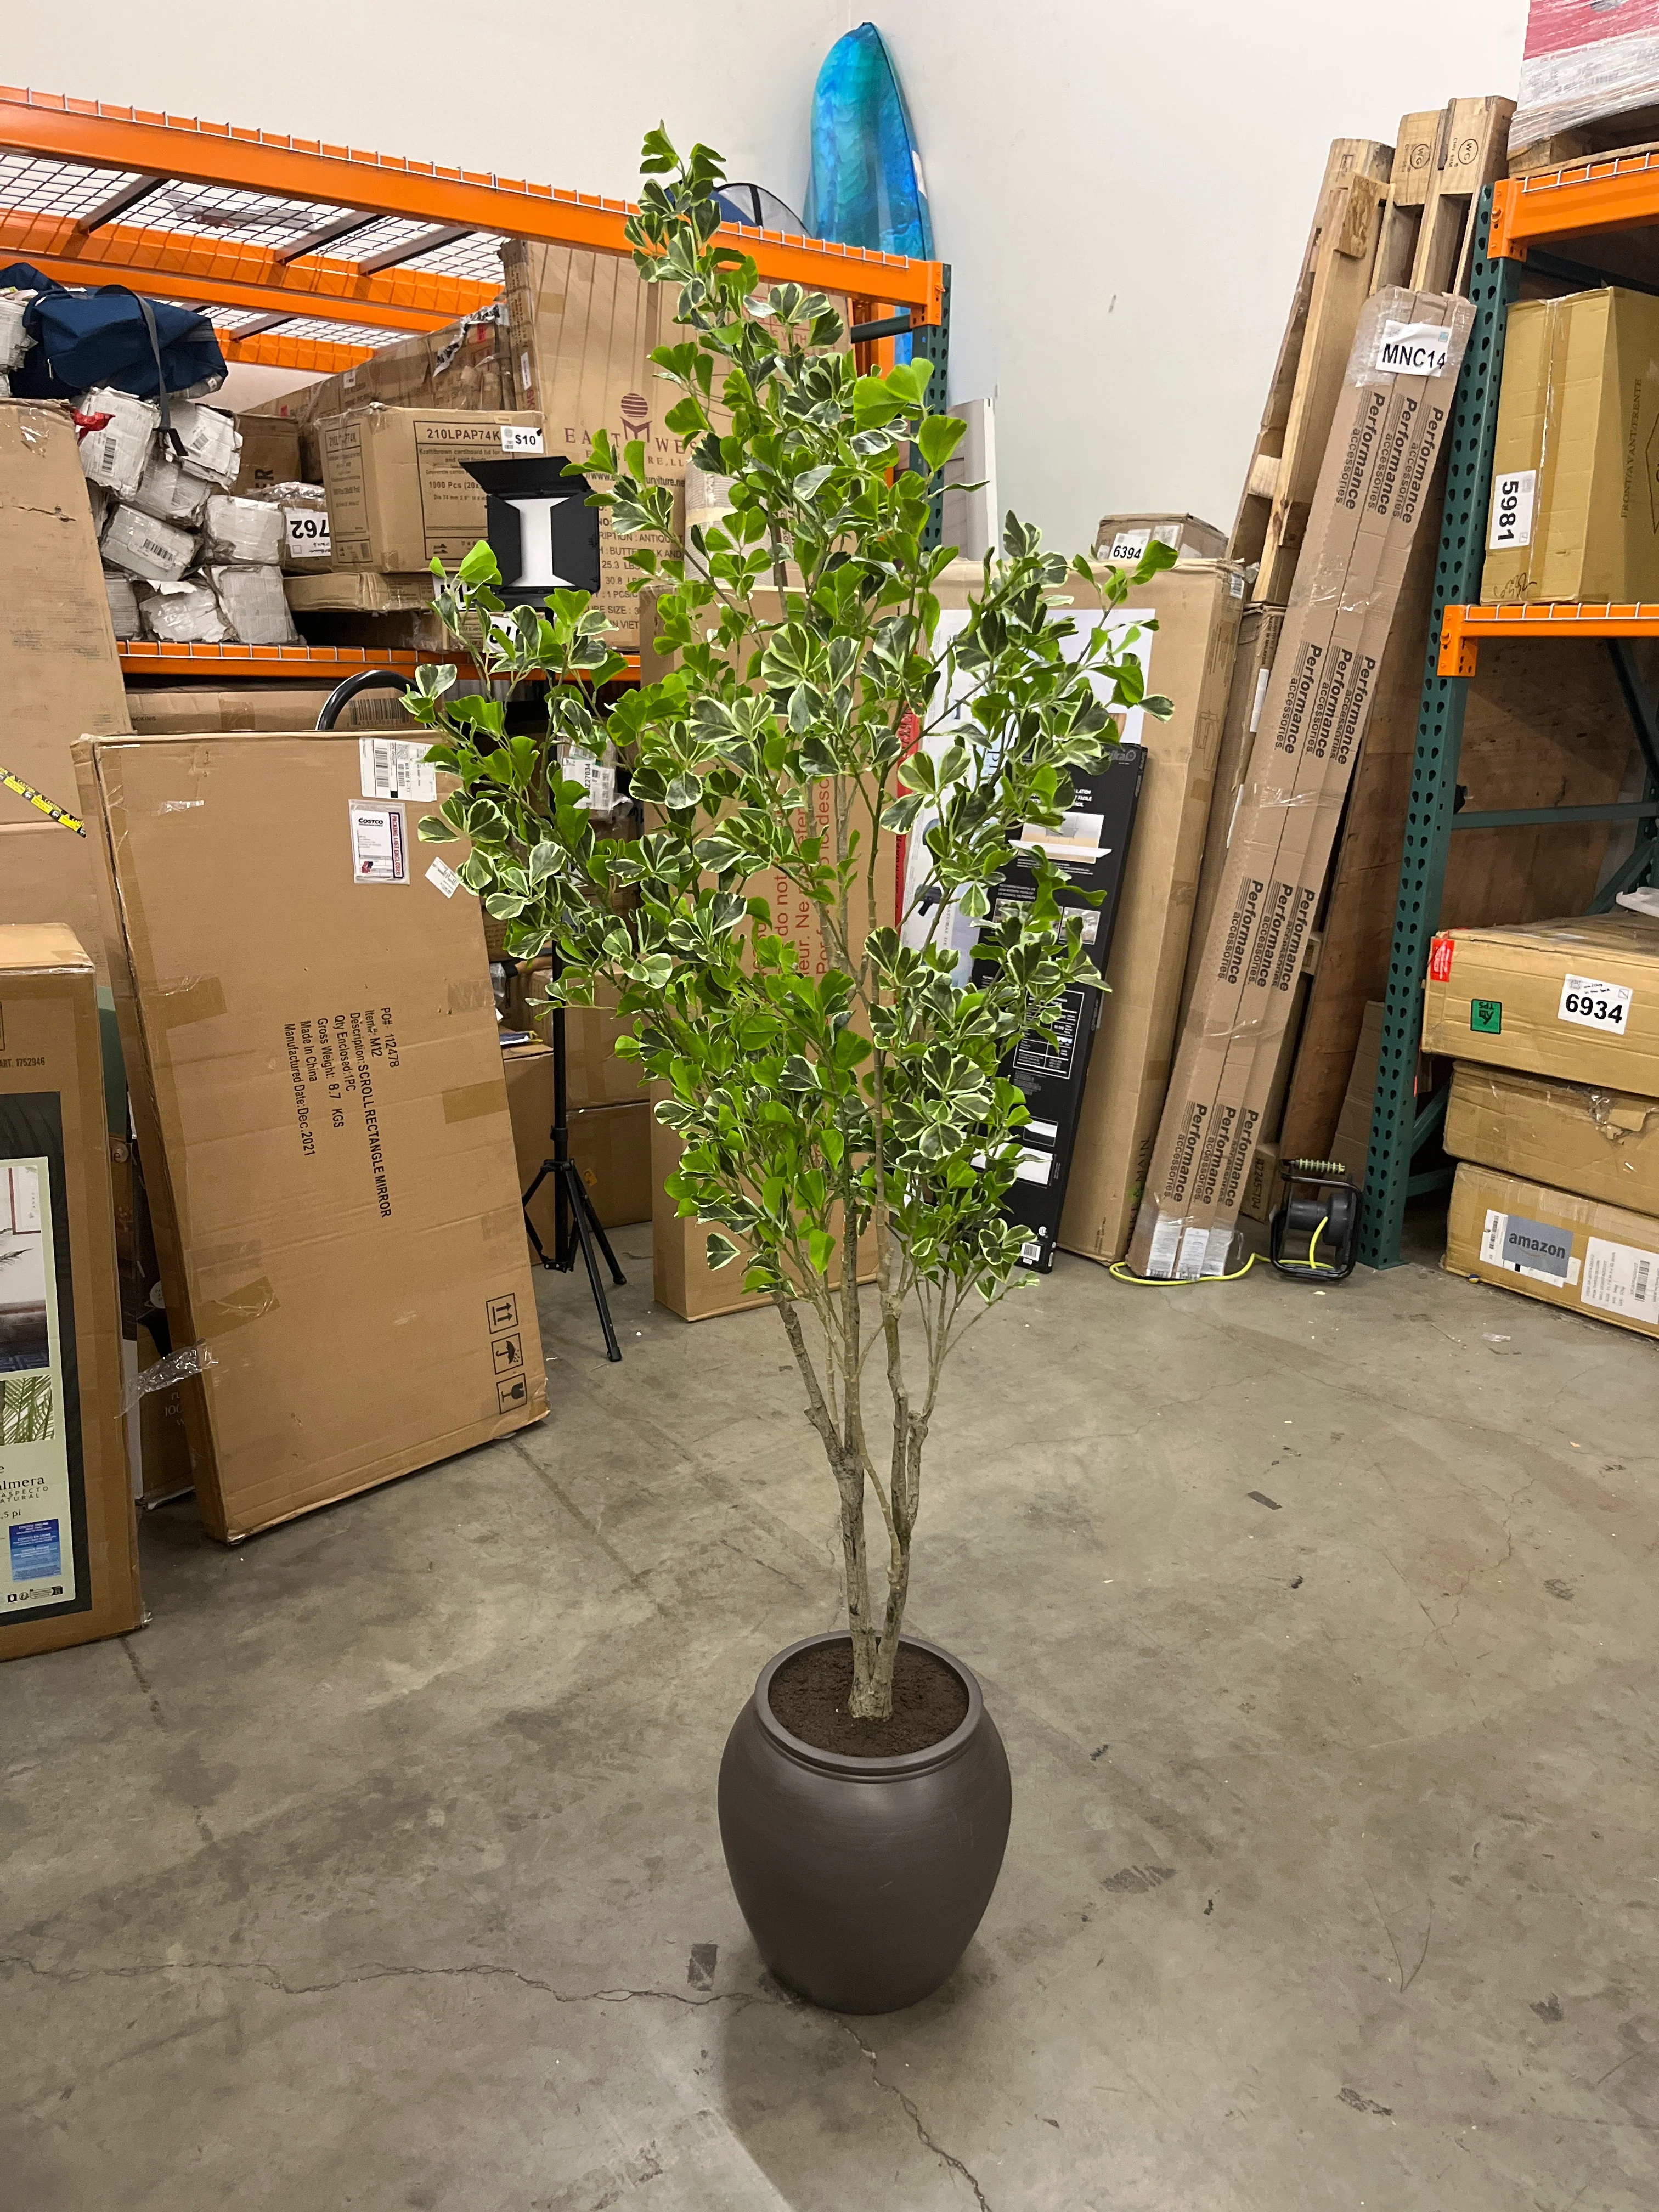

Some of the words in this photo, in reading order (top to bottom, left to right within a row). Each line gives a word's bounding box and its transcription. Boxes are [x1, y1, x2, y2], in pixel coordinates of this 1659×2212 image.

[1464, 142, 1473, 160] WG
[1382, 343, 1446, 369] MNC14
[427, 428, 501, 441] 210LPAP74K
[564, 428, 620, 448] EAT
[1346, 392, 1385, 510] Performance
[1378, 397, 1418, 515] Performance
[1402, 407, 1444, 523] Performance
[1498, 481, 1519, 541] 5981
[1113, 545, 1142, 559] 6394
[608, 606, 627, 614] SIZE
[620, 620, 639, 629] VIET
[1285, 644, 1323, 754] Performance
[1315, 648, 1353, 758] Performance
[1338, 656, 1376, 765] Performance
[774, 874, 788, 905] not
[774, 912, 788, 936] do
[795, 901, 810, 928] Ne
[1228, 880, 1264, 984] Performance
[1257, 883, 1293, 988] Performance
[1279, 888, 1316, 992] Performance
[333, 1015, 346, 1030] Qty
[1566, 994, 1623, 1024] 6934
[300, 1020, 313, 1044] Made
[317, 1018, 329, 1045] Gross
[284, 1023, 304, 1083] Manufactured
[303, 1046, 314, 1055] In
[370, 1037, 382, 1057] M12
[385, 1034, 399, 1068] 112478
[16, 1057, 45, 1068] 1752946
[306, 1056, 318, 1082] China
[321, 1045, 335, 1079] Weight:
[329, 1083, 341, 1099] 8.7
[332, 1108, 344, 1128] KGS
[365, 1109, 385, 1174] RECTANGLE
[375, 1175, 391, 1218] MIRROR
[1173, 1103, 1207, 1203] Performance
[1203, 1106, 1237, 1205] Performance
[1225, 1109, 1259, 1207] Performance
[1509, 1233, 1565, 1259] amazon
[2, 1486, 48, 1497] ASPECTO
[12, 1509, 21, 1519] pi
